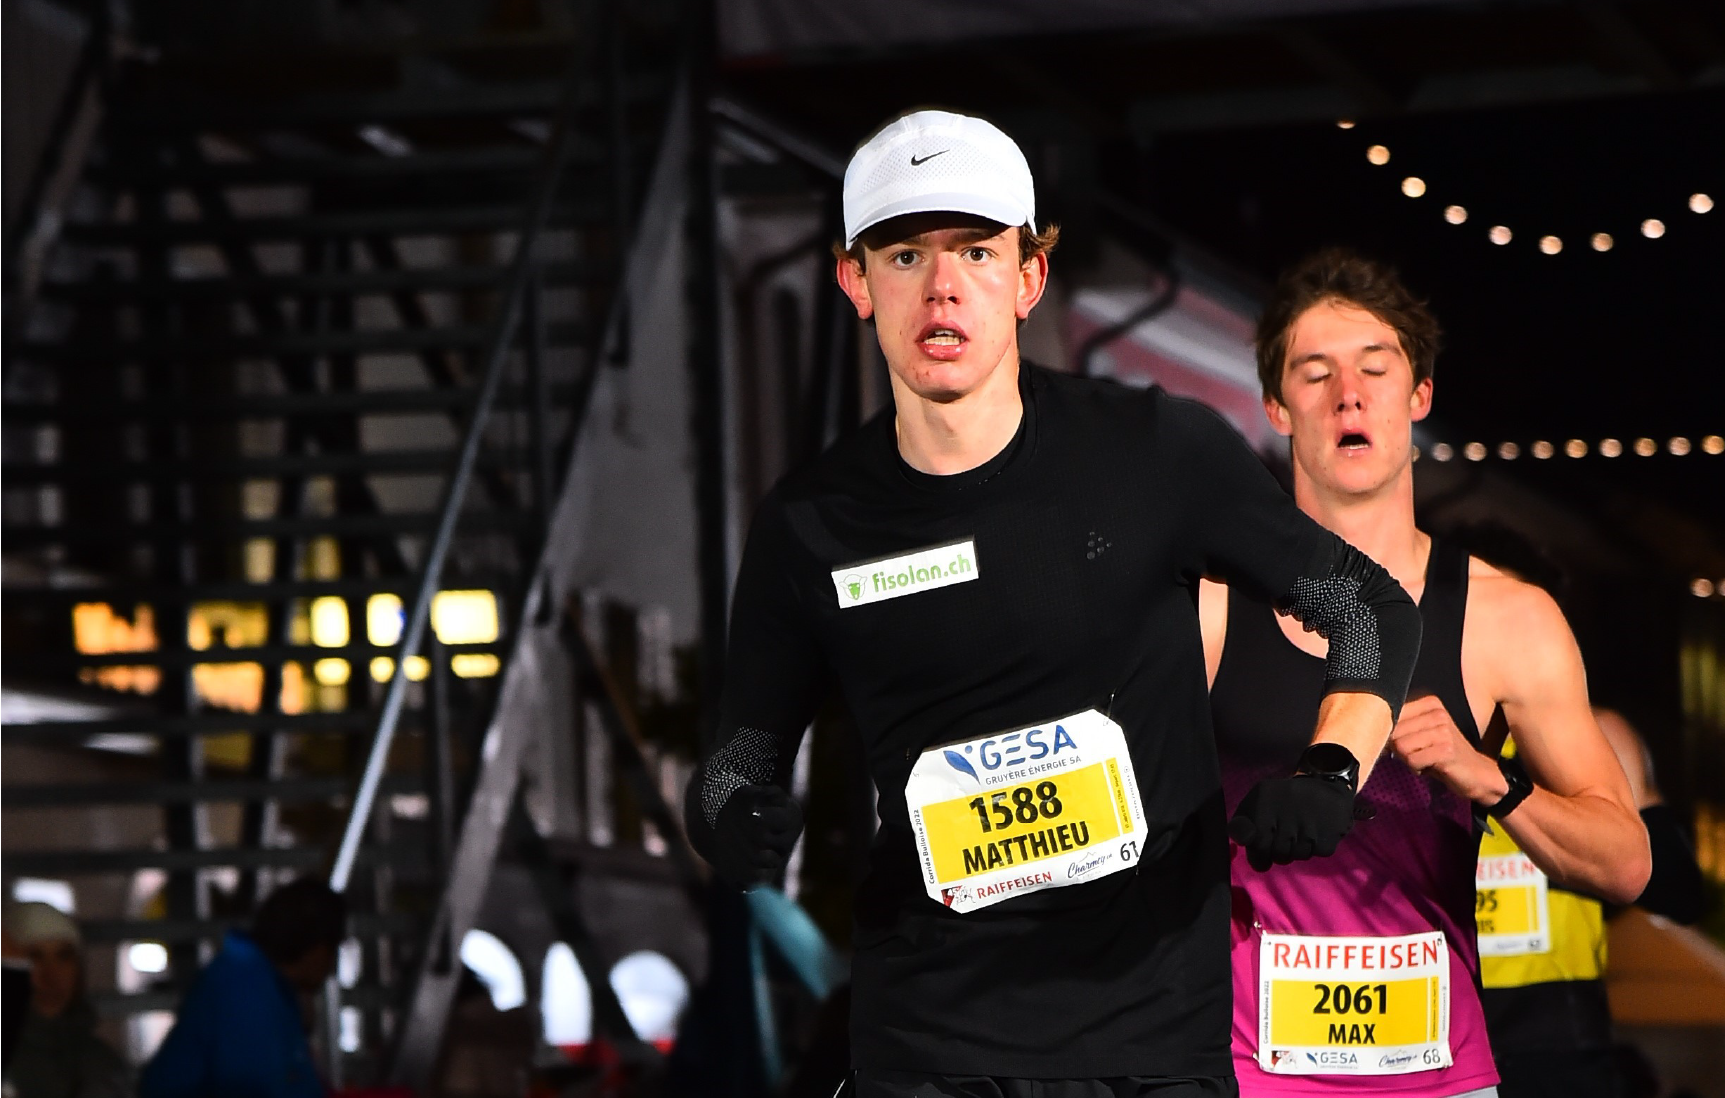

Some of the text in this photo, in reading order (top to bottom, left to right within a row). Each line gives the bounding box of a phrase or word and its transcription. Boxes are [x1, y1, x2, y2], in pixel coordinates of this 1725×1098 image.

[871, 554, 972, 593] fisolan.ch
[979, 725, 1078, 770] GESA
[985, 755, 1082, 786] GRUYÈRE ÉNERGIE SA
[969, 781, 1063, 833] 1588
[913, 809, 935, 884] Corrida Bulloise 2022
[962, 821, 1090, 875] MATTHIEU
[1119, 840, 1140, 861] 61
[976, 871, 1053, 899] RAIFFEISEN
[1273, 940, 1438, 970] RAIFFEISEN
[1313, 984, 1387, 1015] 2061
[1328, 1023, 1376, 1045] MAX
[1320, 1052, 1358, 1064] GESA
[1423, 1049, 1441, 1064] 68
